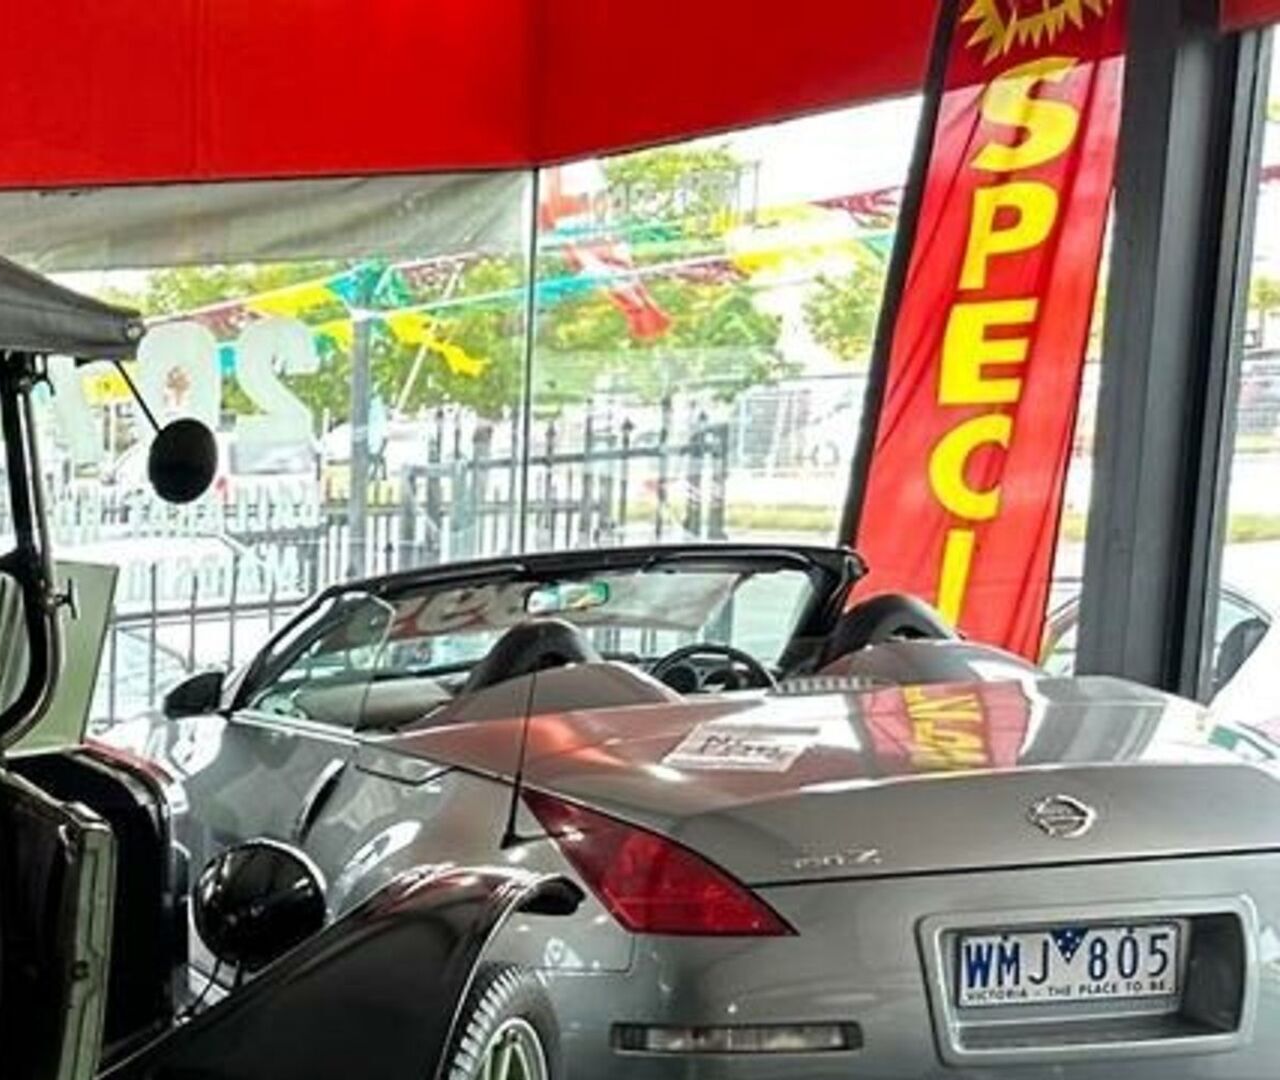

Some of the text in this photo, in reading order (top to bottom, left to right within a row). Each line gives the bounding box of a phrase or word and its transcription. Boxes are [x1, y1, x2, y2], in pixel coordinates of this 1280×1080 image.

[929, 56, 1081, 627] SPECI
[965, 933, 1170, 988] WMJ 805
[967, 988, 1028, 1001] VICTORIA
[1048, 984, 1072, 997] THE
[1078, 980, 1118, 996] PLACE
[1125, 980, 1143, 992] TO
